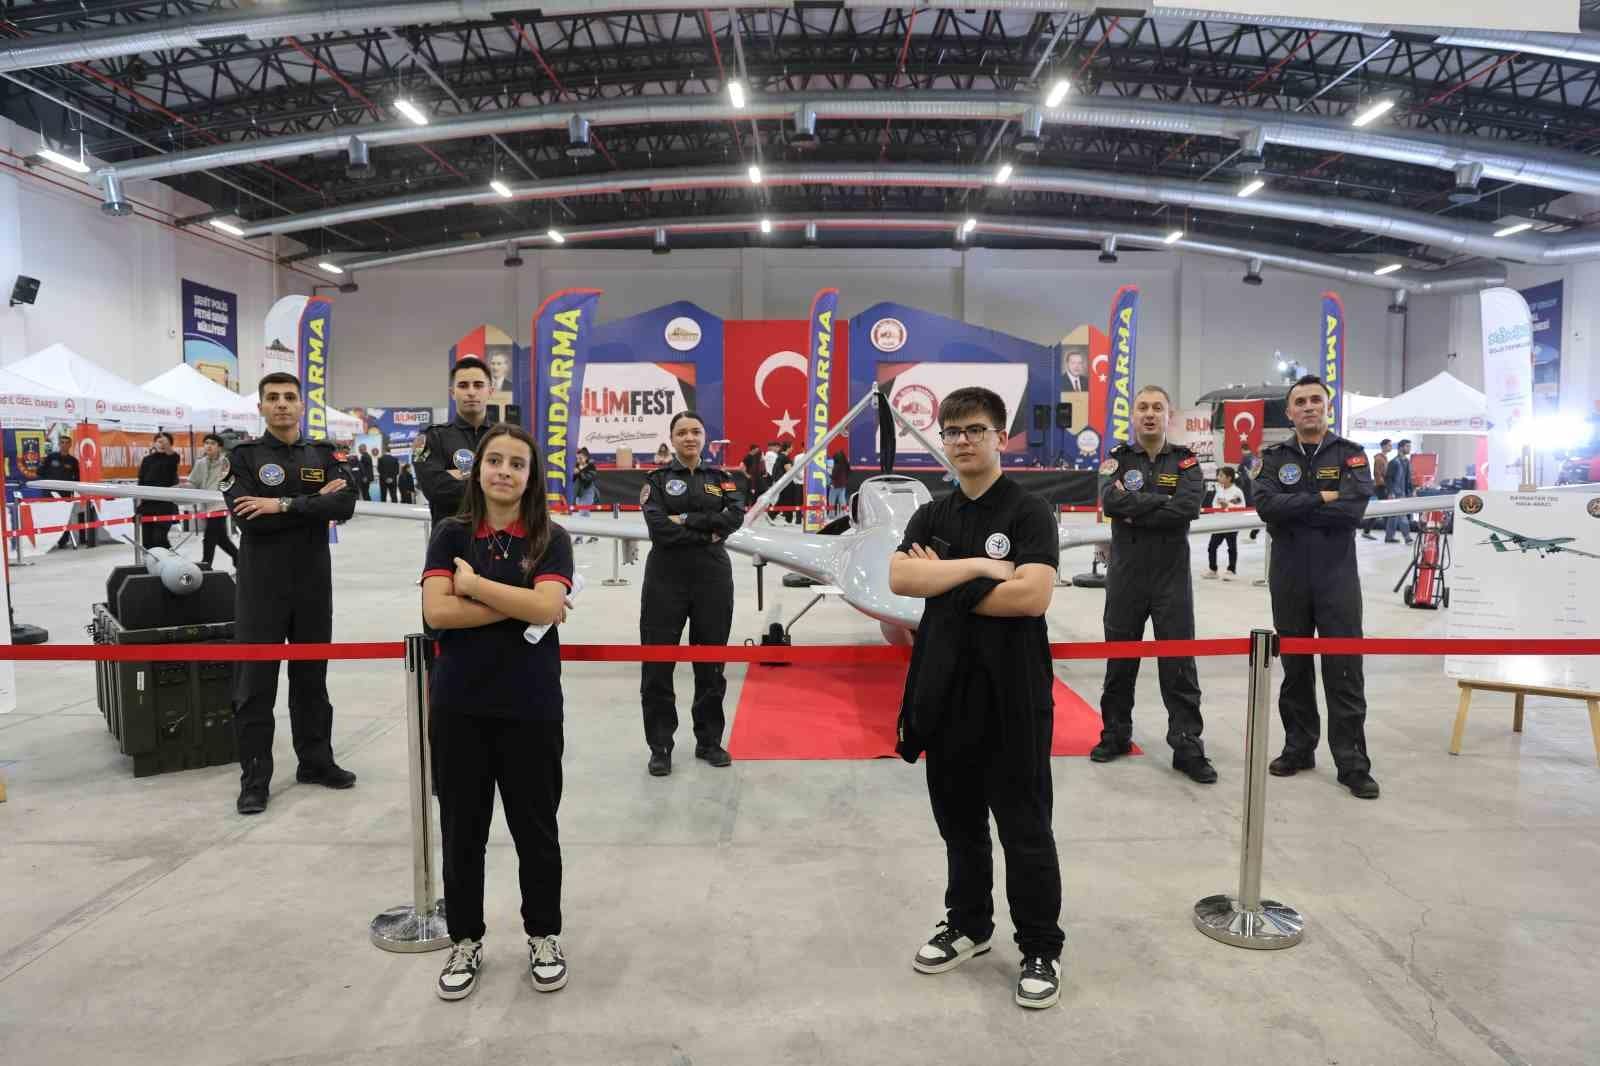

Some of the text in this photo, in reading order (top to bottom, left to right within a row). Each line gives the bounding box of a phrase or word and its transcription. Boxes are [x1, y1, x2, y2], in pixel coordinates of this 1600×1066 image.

[547, 309, 582, 488] JANDARMA
[580, 387, 675, 416] İLİMFEST
[813, 311, 832, 487] JANDARMA
